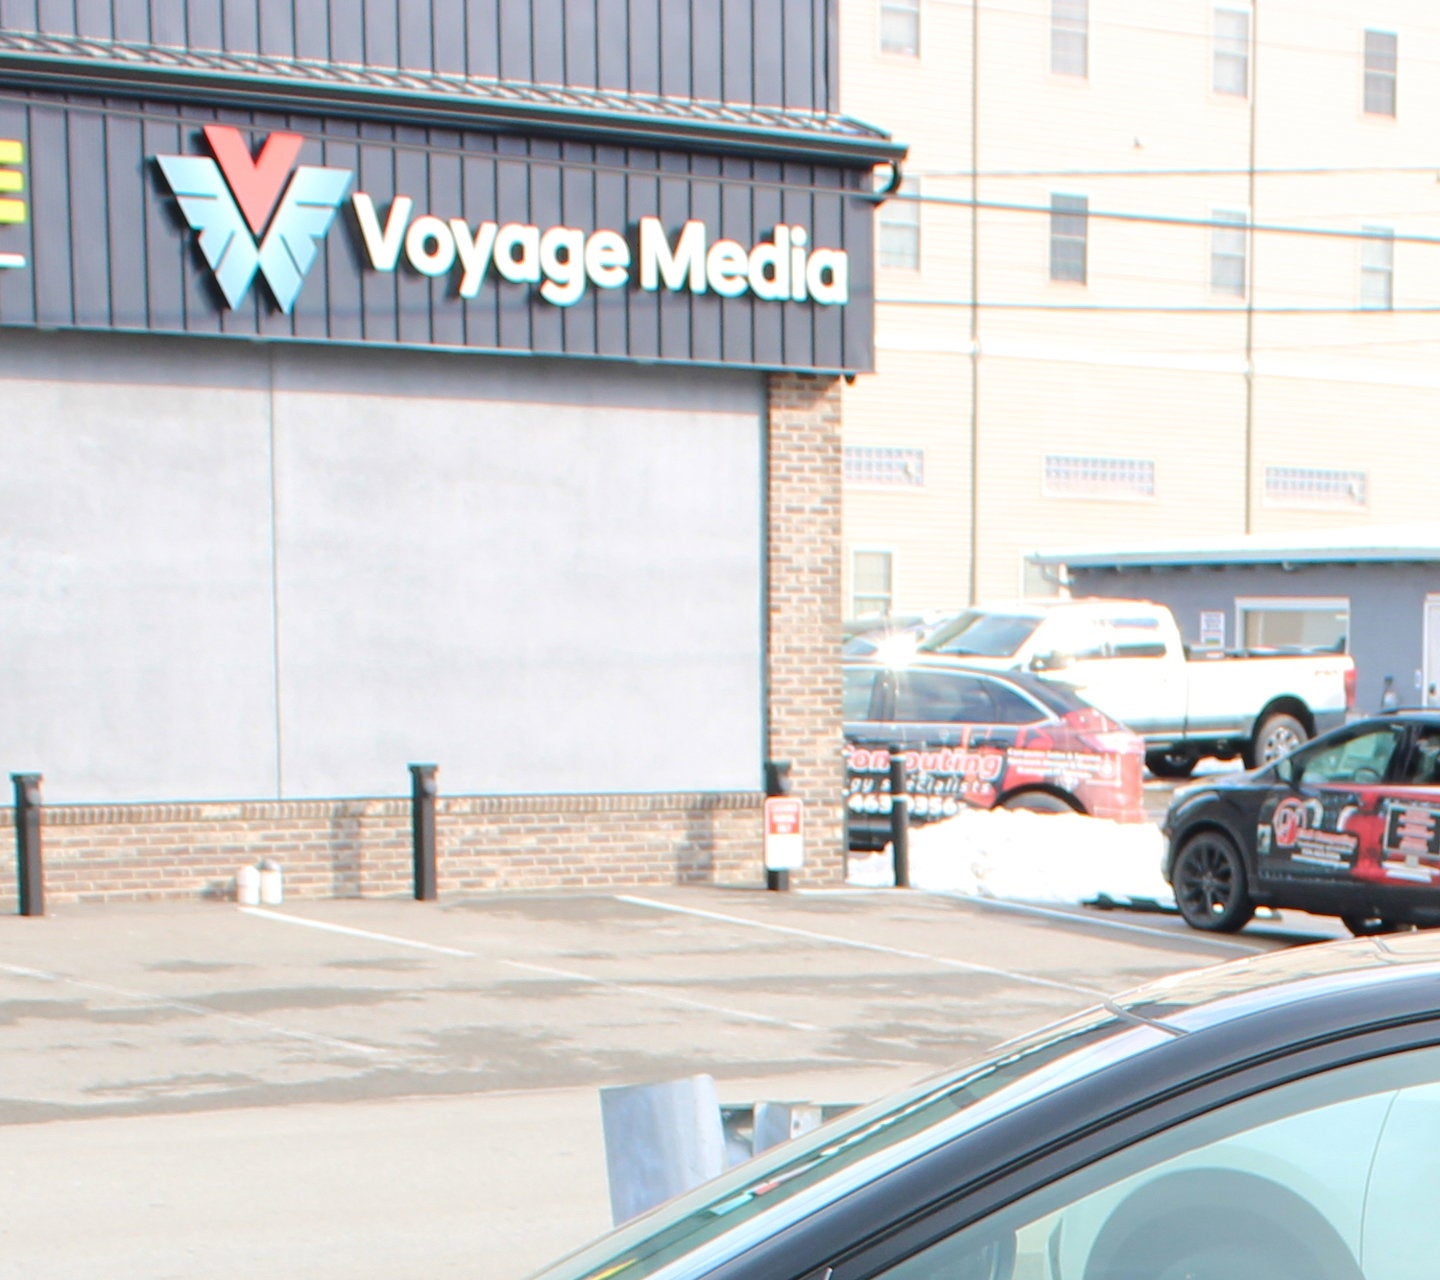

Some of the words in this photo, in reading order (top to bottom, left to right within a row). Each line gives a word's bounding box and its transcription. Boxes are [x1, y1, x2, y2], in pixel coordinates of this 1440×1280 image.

[352, 192, 630, 305] Voyage
[640, 216, 848, 305] Media
[880, 775, 993, 795] secialists
